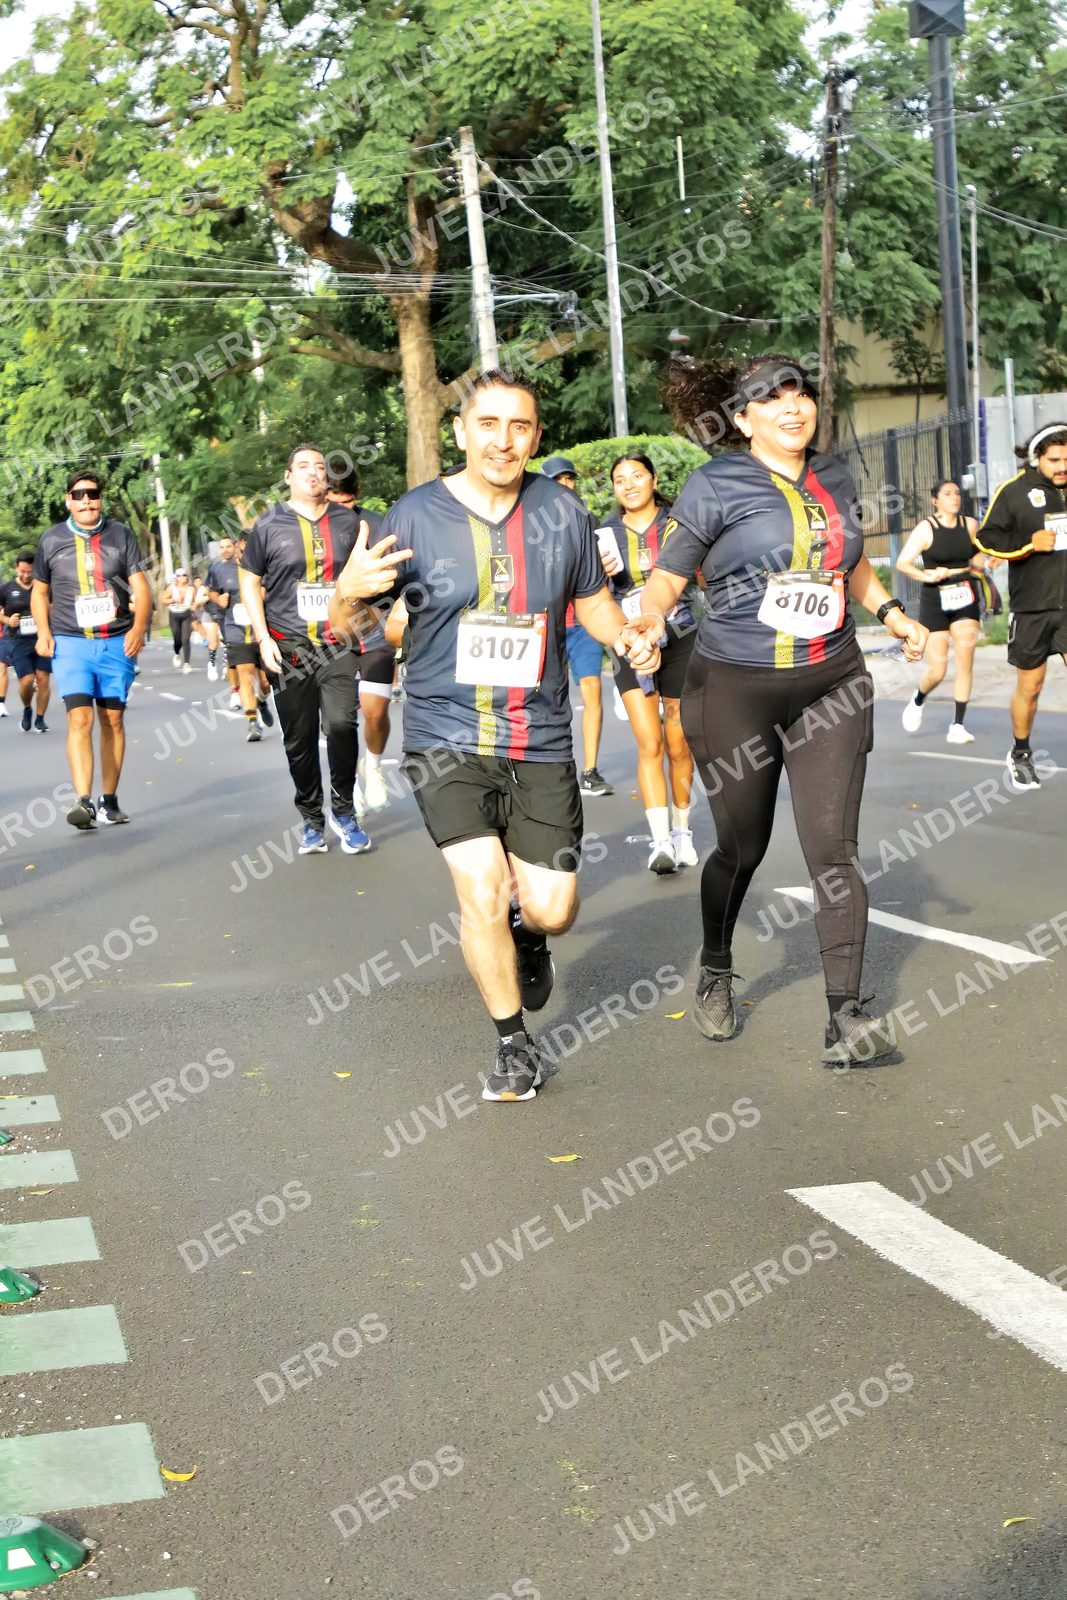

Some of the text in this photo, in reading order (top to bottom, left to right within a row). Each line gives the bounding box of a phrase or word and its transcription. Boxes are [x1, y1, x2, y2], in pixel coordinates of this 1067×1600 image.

[81, 602, 111, 615] 11082
[776, 590, 829, 617] 8106
[469, 635, 530, 661] 8107
